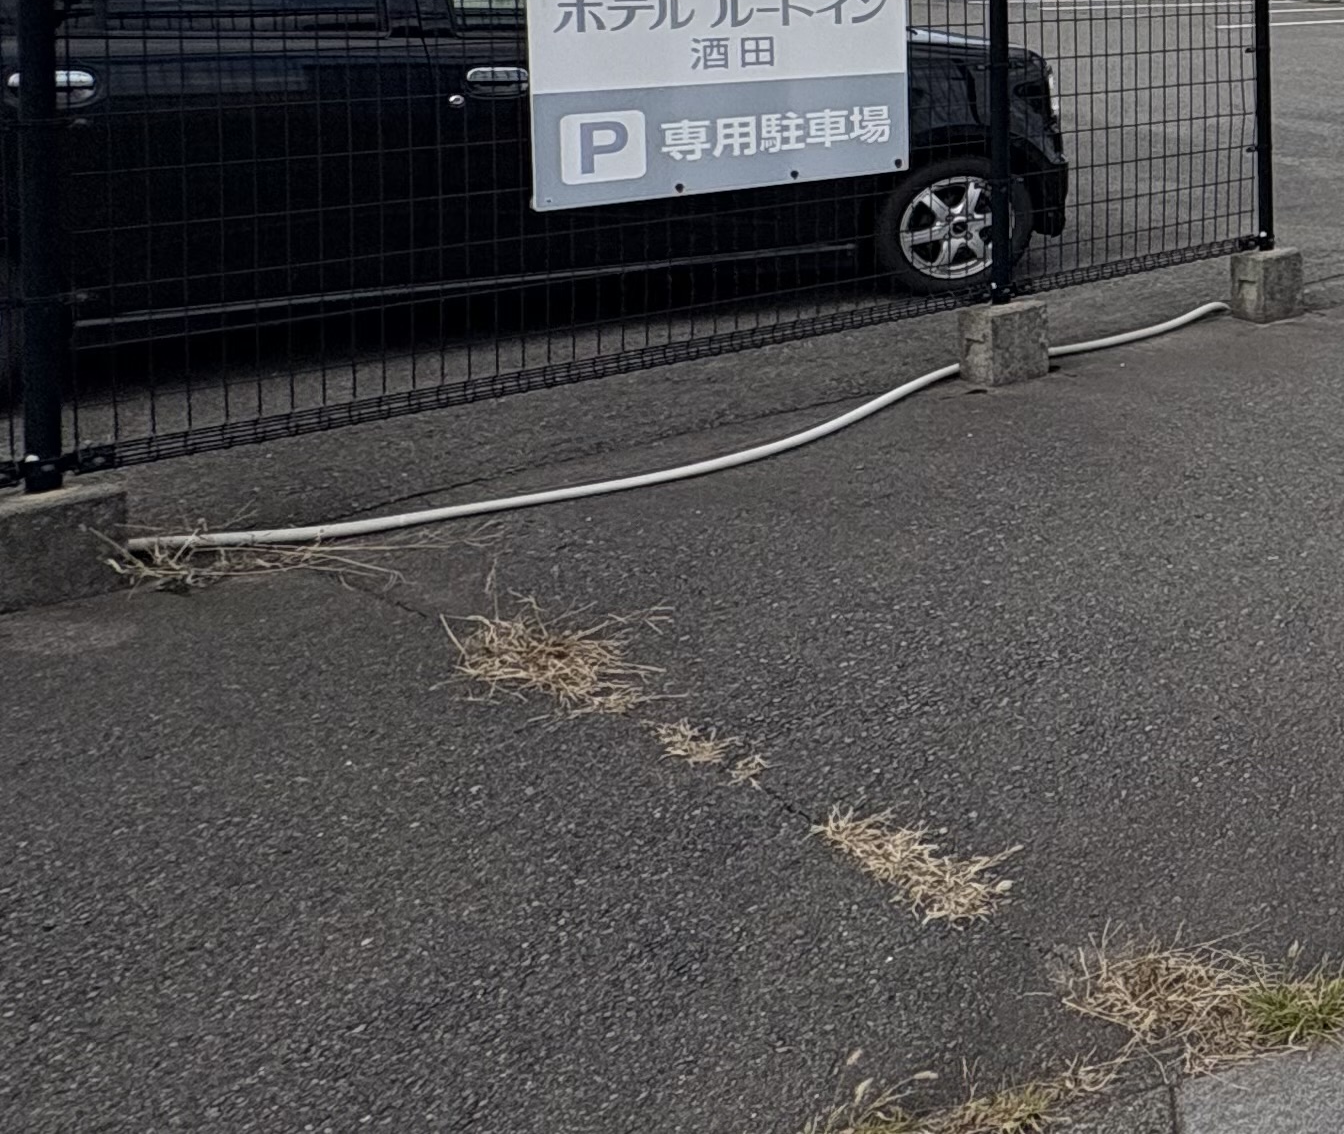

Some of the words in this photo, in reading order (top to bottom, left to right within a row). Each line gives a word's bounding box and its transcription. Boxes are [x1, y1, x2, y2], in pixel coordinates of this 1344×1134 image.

[690, 35, 775, 71] 酒田
[579, 121, 629, 175] P
[660, 105, 892, 162] 専用駐車場
